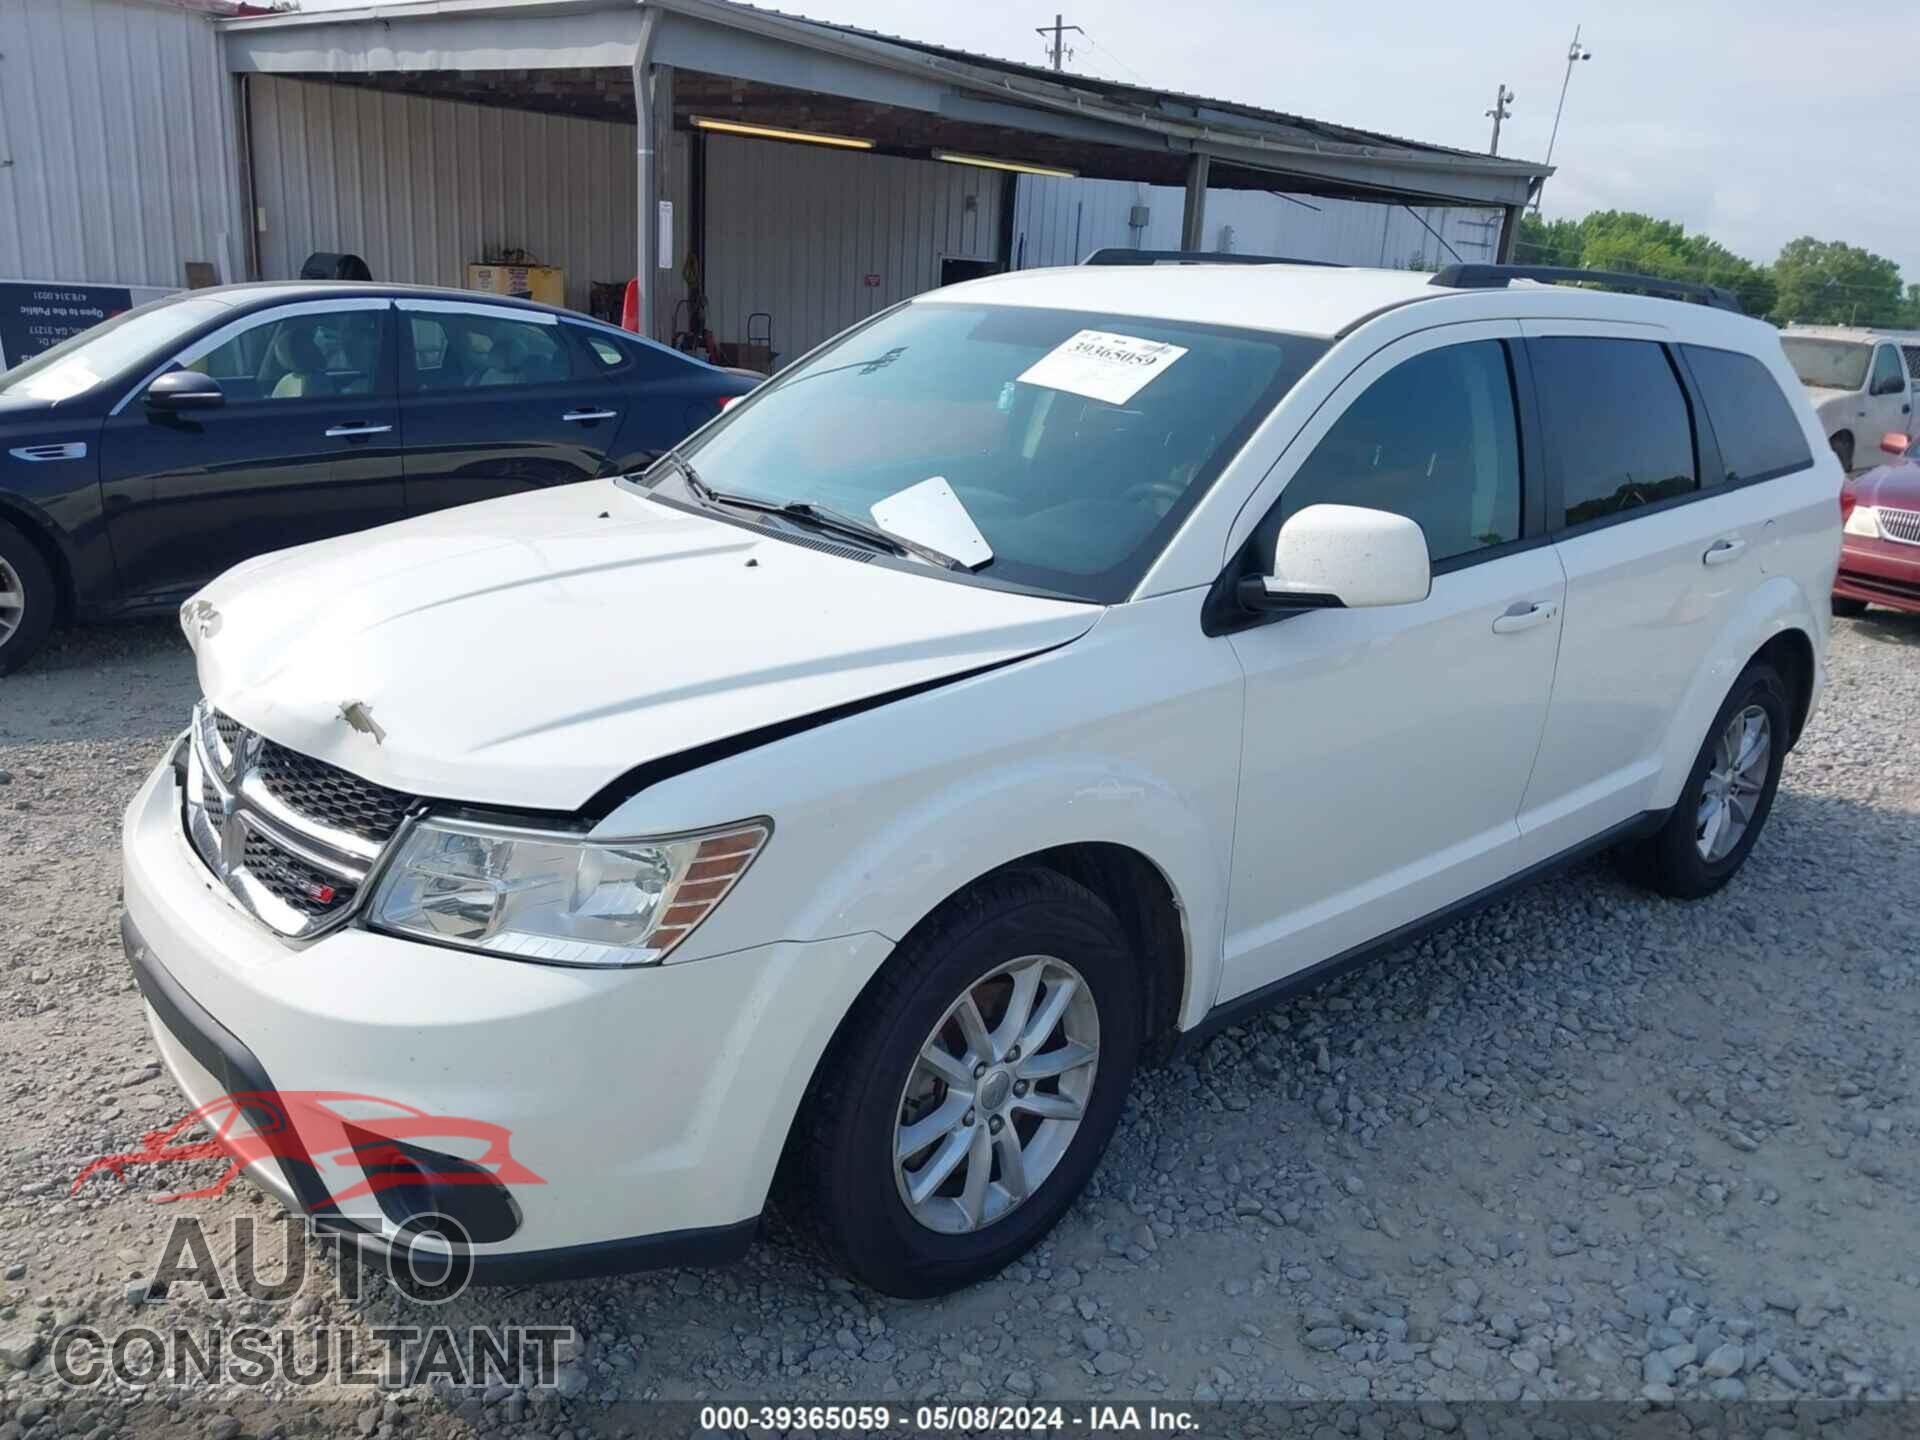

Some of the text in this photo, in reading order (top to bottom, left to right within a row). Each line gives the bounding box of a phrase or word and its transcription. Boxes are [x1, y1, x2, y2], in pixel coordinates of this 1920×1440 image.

[20, 306, 104, 318] Open to the Public
[55, 327, 68, 336] GA
[1073, 341, 1158, 366] 39365059
[266, 856, 322, 898] DODGE
